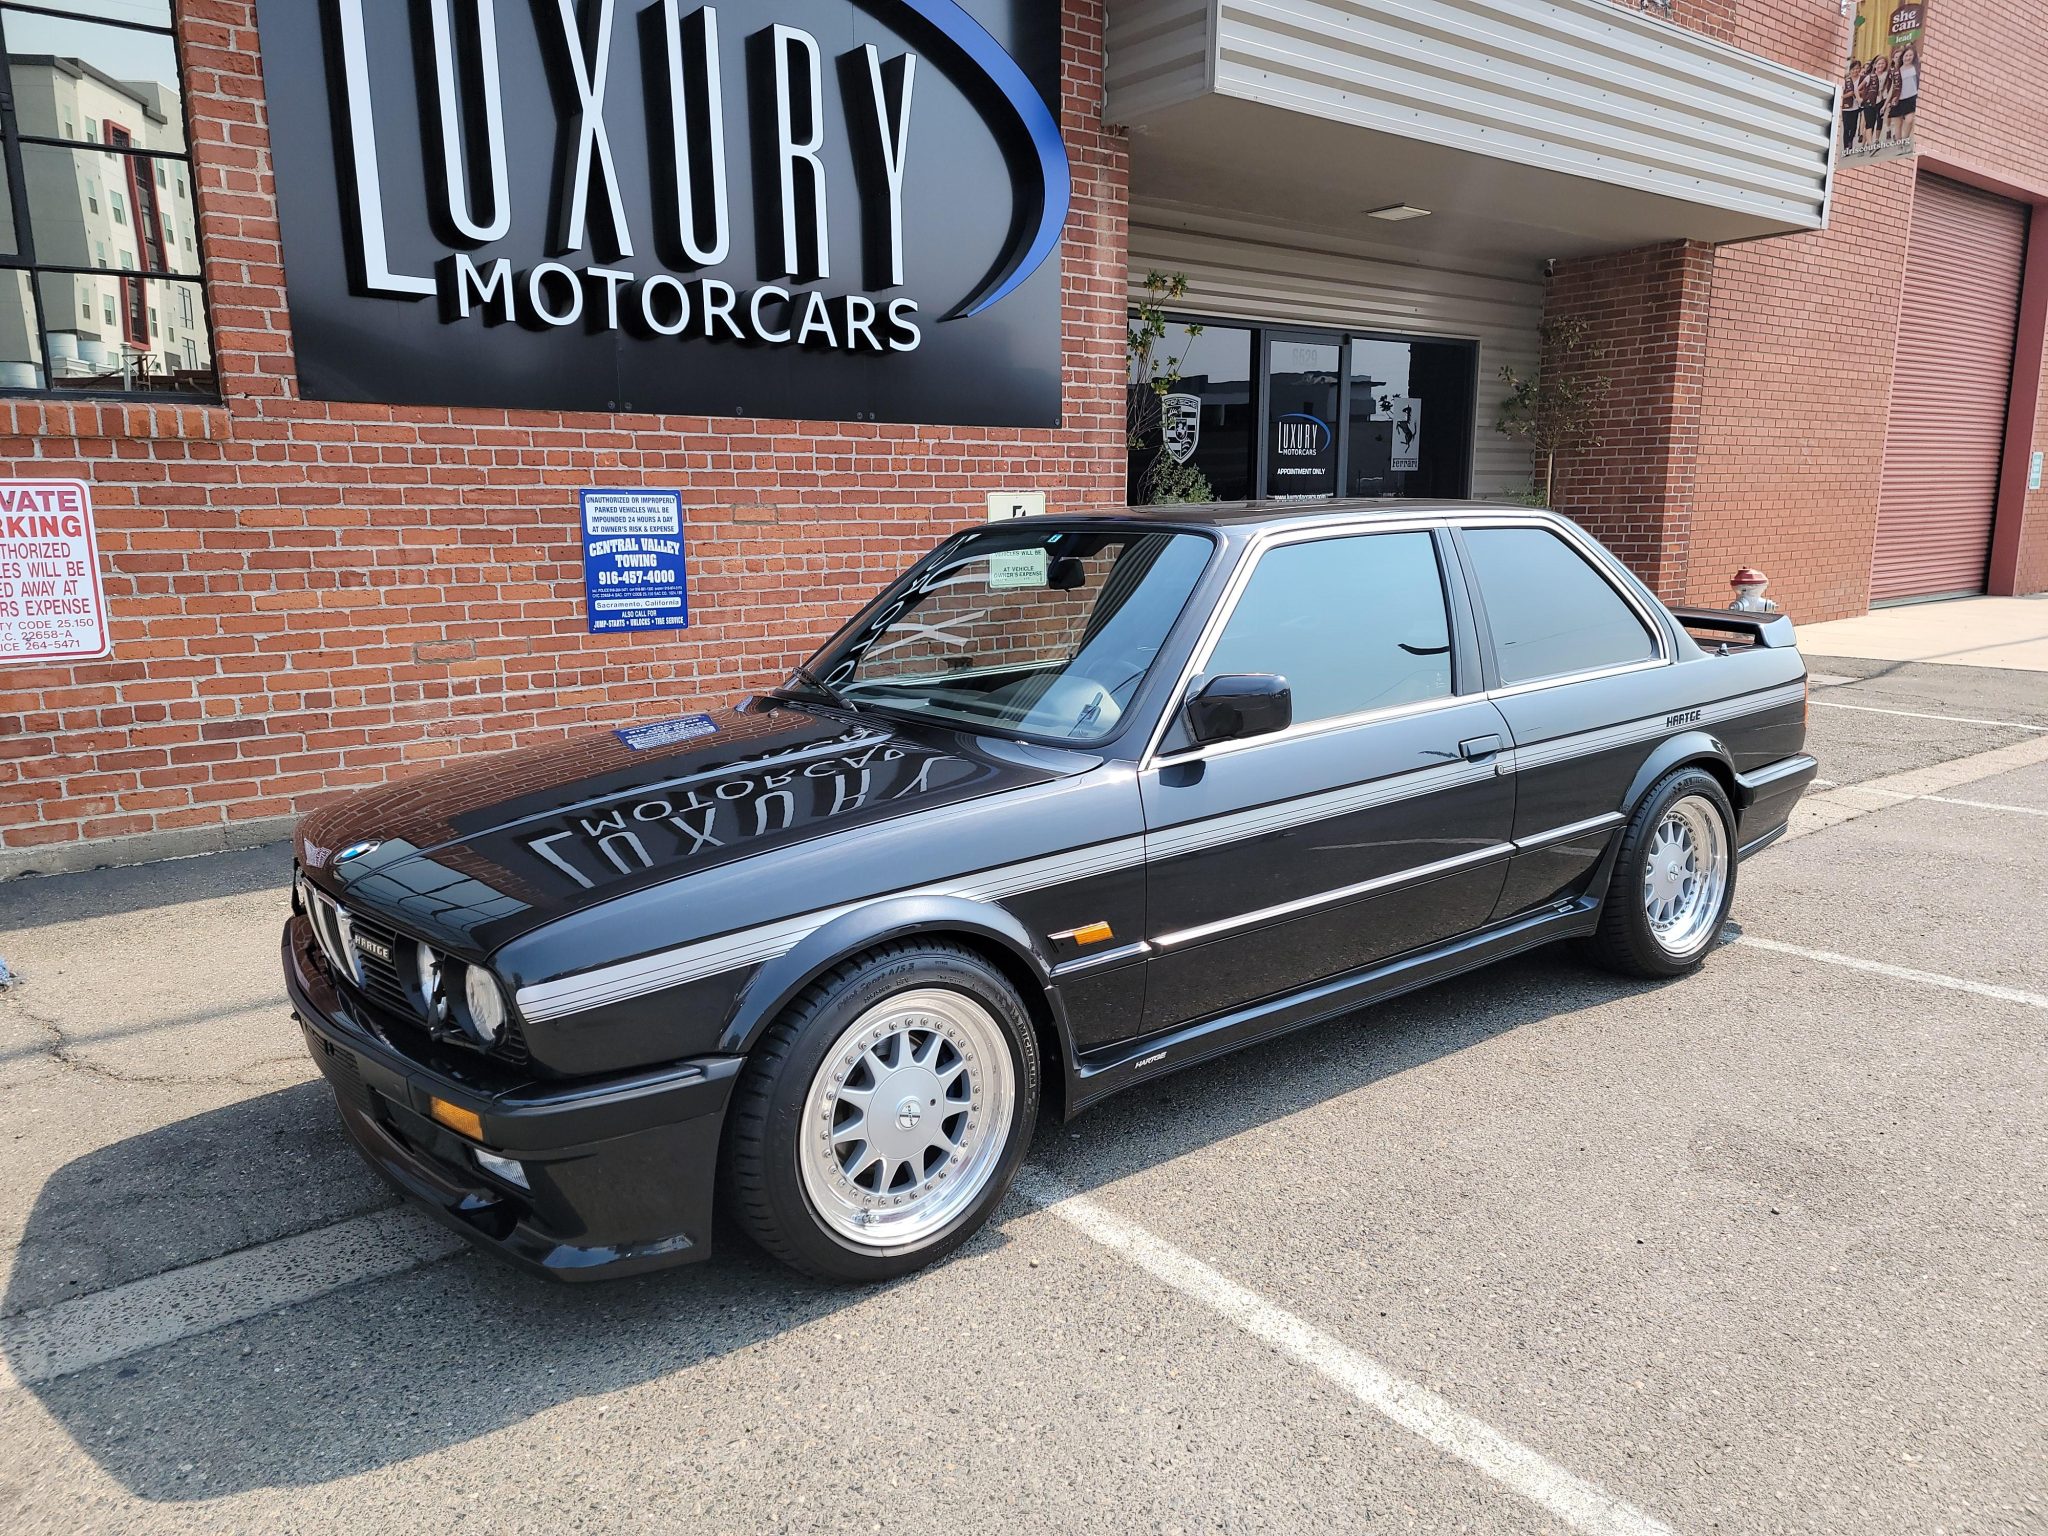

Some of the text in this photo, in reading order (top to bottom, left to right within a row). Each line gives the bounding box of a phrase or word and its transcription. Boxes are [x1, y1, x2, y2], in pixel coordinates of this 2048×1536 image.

[1893, 10, 1917, 23] she
[1892, 20, 1920, 33] can.
[1895, 33, 1913, 43] lead
[340, 0, 917, 295] LUXURY
[454, 253, 922, 353] MOTORCARS
[1278, 421, 1318, 454] LUXURY
[1282, 448, 1317, 456] MOTORCARS
[586, 496, 630, 504] UNAUTHORIZED
[631, 496, 639, 504] OR
[589, 538, 680, 557] CENTRAL VALLEY
[615, 554, 657, 568] TOWING
[0, 561, 85, 578] ES WILL BE
[598, 570, 675, 585] 916-457-4000
[21, 580, 55, 597] AWAY
[64, 580, 78, 596] AT
[25, 598, 91, 616] EXPENSE
[597, 599, 679, 609] Sacramento, California
[18, 620, 52, 630] CODE
[57, 618, 94, 628] 25.150
[666, 616, 684, 624] SERVICE
[21, 630, 72, 641] 22658-A
[26, 639, 80, 651] 264-5471
[1666, 710, 1702, 727] HARTGE
[355, 934, 389, 959] HARTGE
[1134, 1051, 1167, 1069] HARTGE
